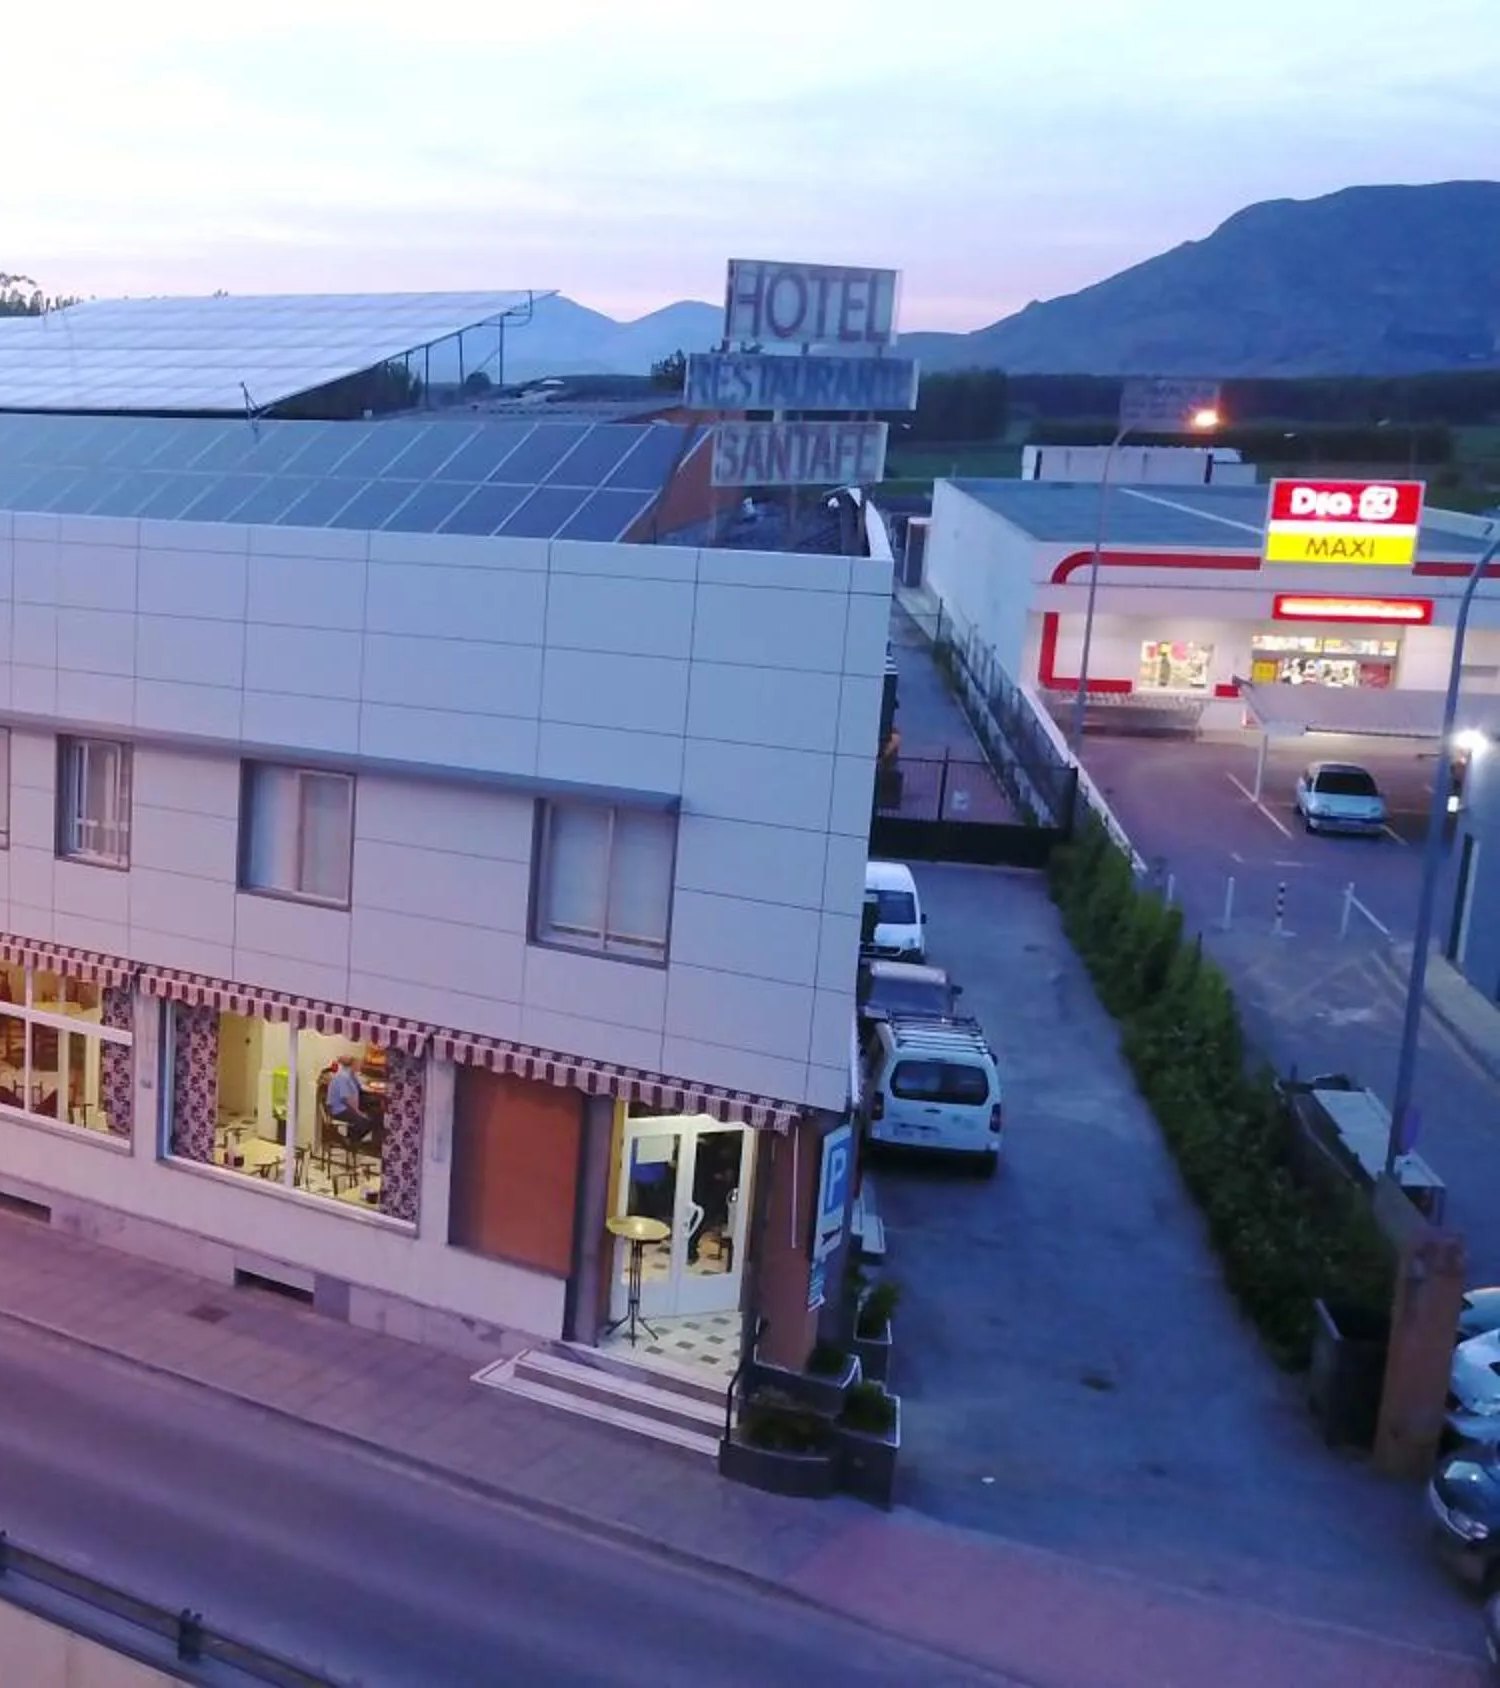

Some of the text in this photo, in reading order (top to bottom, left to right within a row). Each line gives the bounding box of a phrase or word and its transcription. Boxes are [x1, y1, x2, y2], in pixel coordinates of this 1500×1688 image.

[733, 265, 891, 342] HOTEL
[1305, 537, 1375, 559] MAXI
[826, 1147, 847, 1209] P
